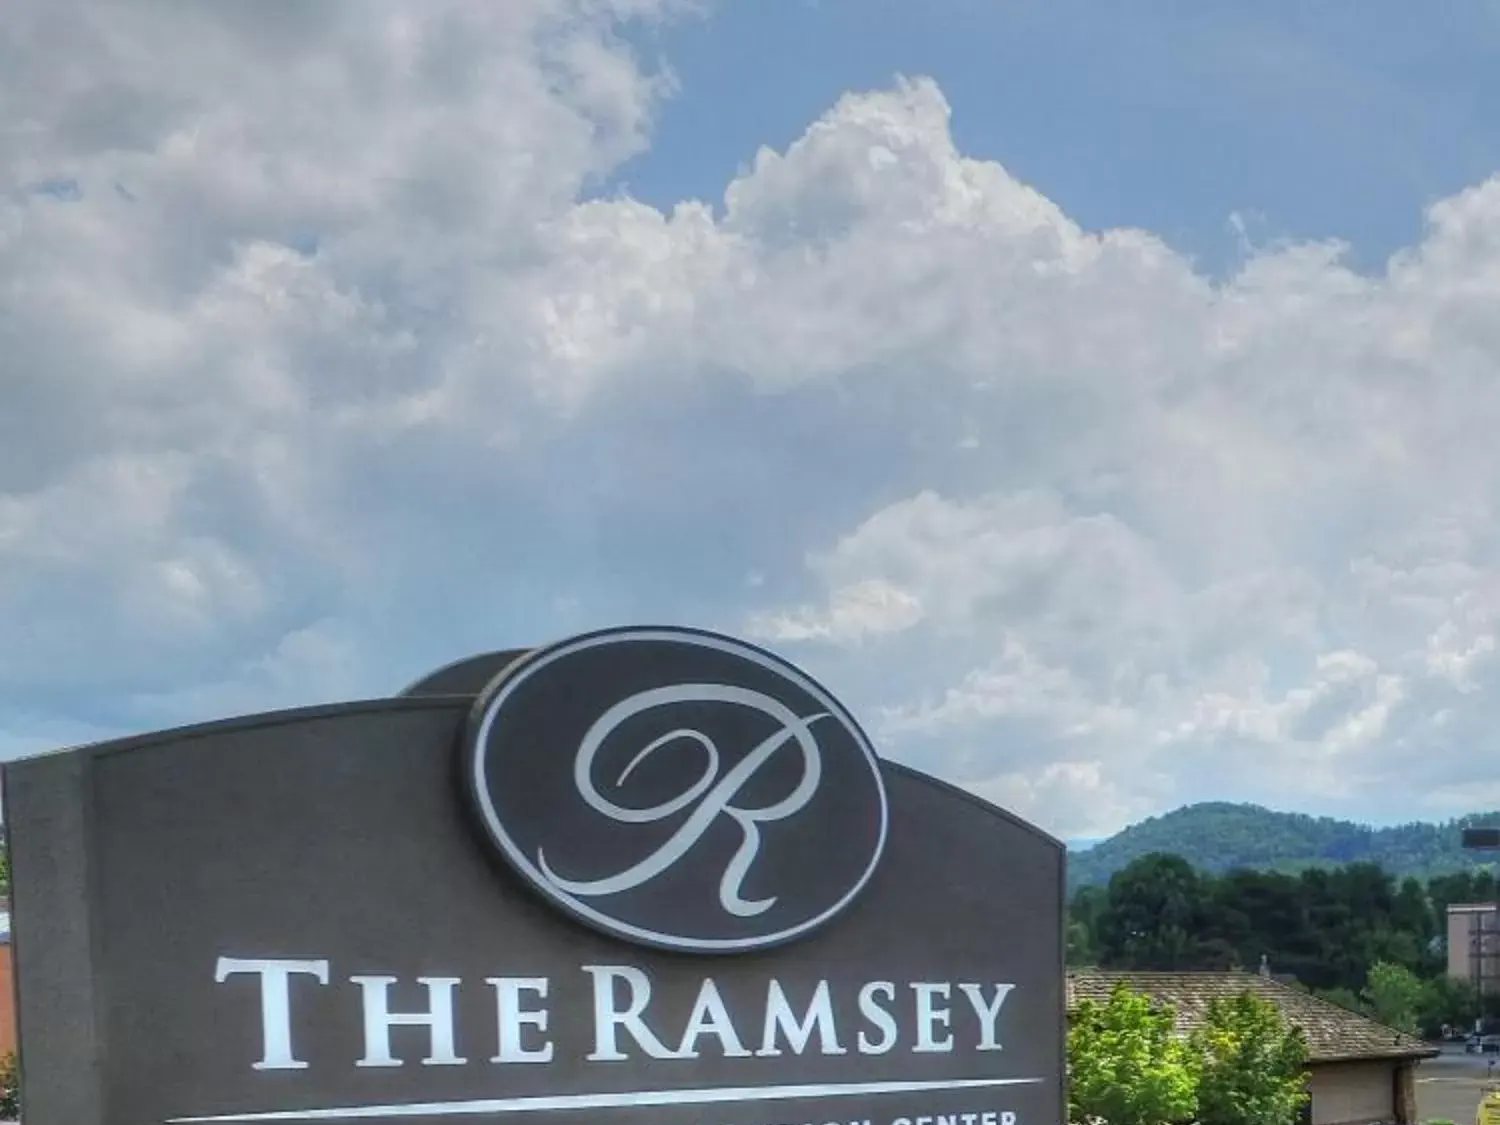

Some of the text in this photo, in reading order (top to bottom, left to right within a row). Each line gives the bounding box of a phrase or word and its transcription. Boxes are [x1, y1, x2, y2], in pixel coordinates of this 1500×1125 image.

[537, 682, 831, 918] R
[214, 956, 1016, 1070] THE RAMSEY
